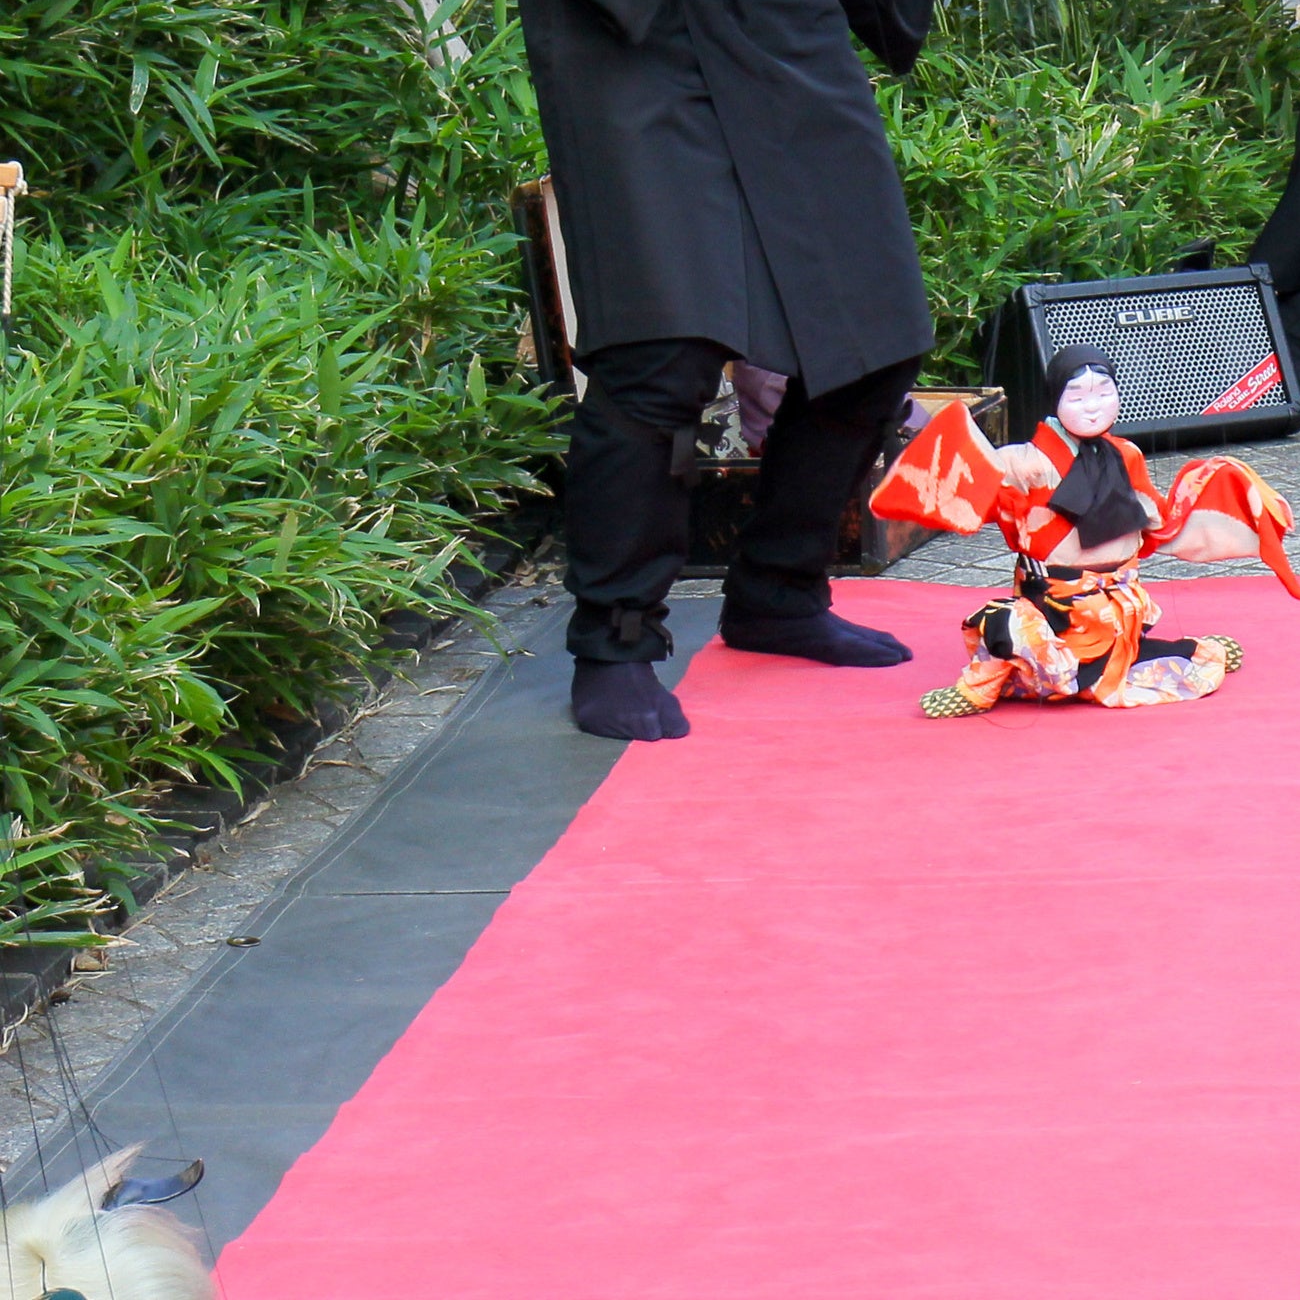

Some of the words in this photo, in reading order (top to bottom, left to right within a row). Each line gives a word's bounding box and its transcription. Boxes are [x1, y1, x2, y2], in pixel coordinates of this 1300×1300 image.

[1119, 306, 1193, 326] CUBE
[1247, 362, 1278, 394] Street
[1212, 386, 1241, 412] Roland
